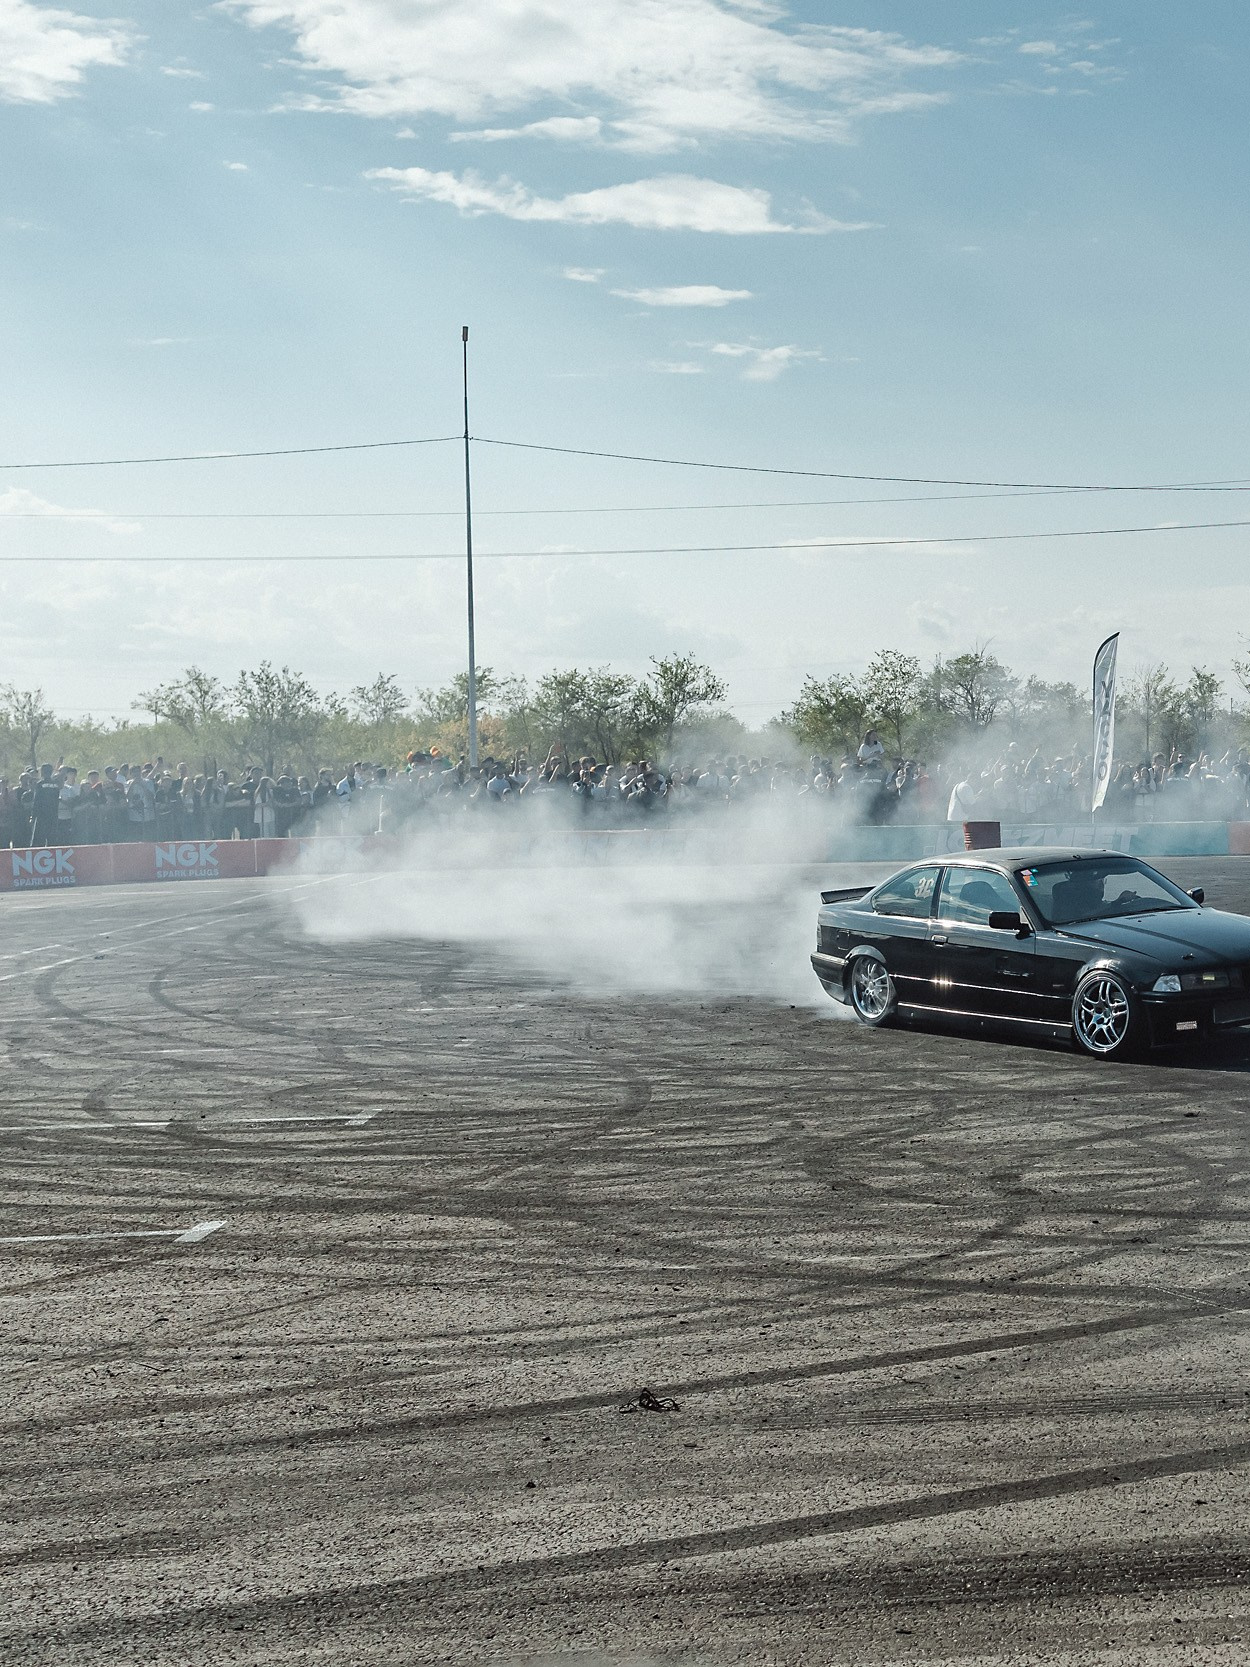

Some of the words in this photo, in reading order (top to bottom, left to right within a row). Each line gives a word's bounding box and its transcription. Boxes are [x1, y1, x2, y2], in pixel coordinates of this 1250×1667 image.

[934, 826, 1139, 855] LOKZMEET
[12, 848, 75, 876] NGK
[155, 843, 219, 867] NGK
[13, 877, 43, 887] SPARK
[45, 875, 76, 885] PLUGS
[156, 869, 187, 878] SPARK
[188, 868, 219, 877] PLUGS
